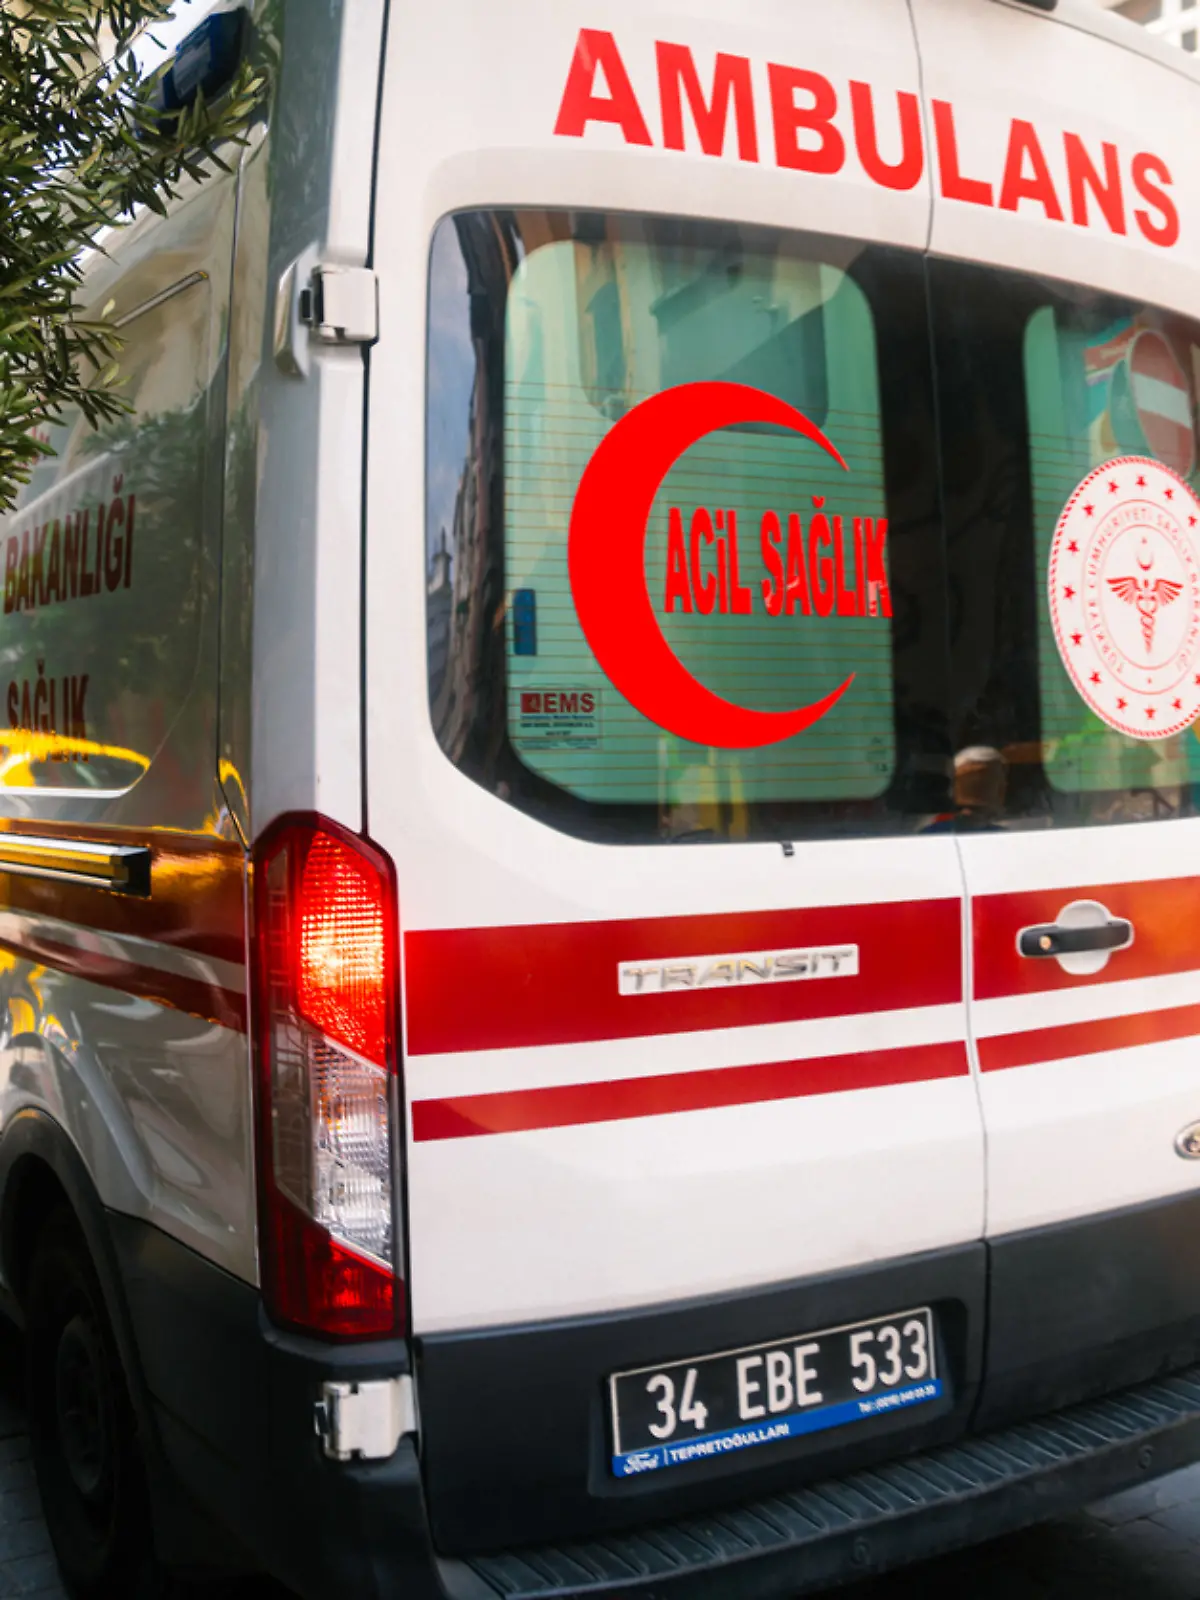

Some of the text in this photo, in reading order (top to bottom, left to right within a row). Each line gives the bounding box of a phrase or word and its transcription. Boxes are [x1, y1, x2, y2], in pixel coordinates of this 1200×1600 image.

[553, 27, 1181, 248] AMBULANS
[4, 473, 136, 615] BAKANLIĞI
[760, 495, 894, 618] SAĞLIK
[543, 692, 595, 714] EMS
[622, 949, 854, 991] TRANSIT
[645, 1320, 928, 1439] 34 EBE 533
